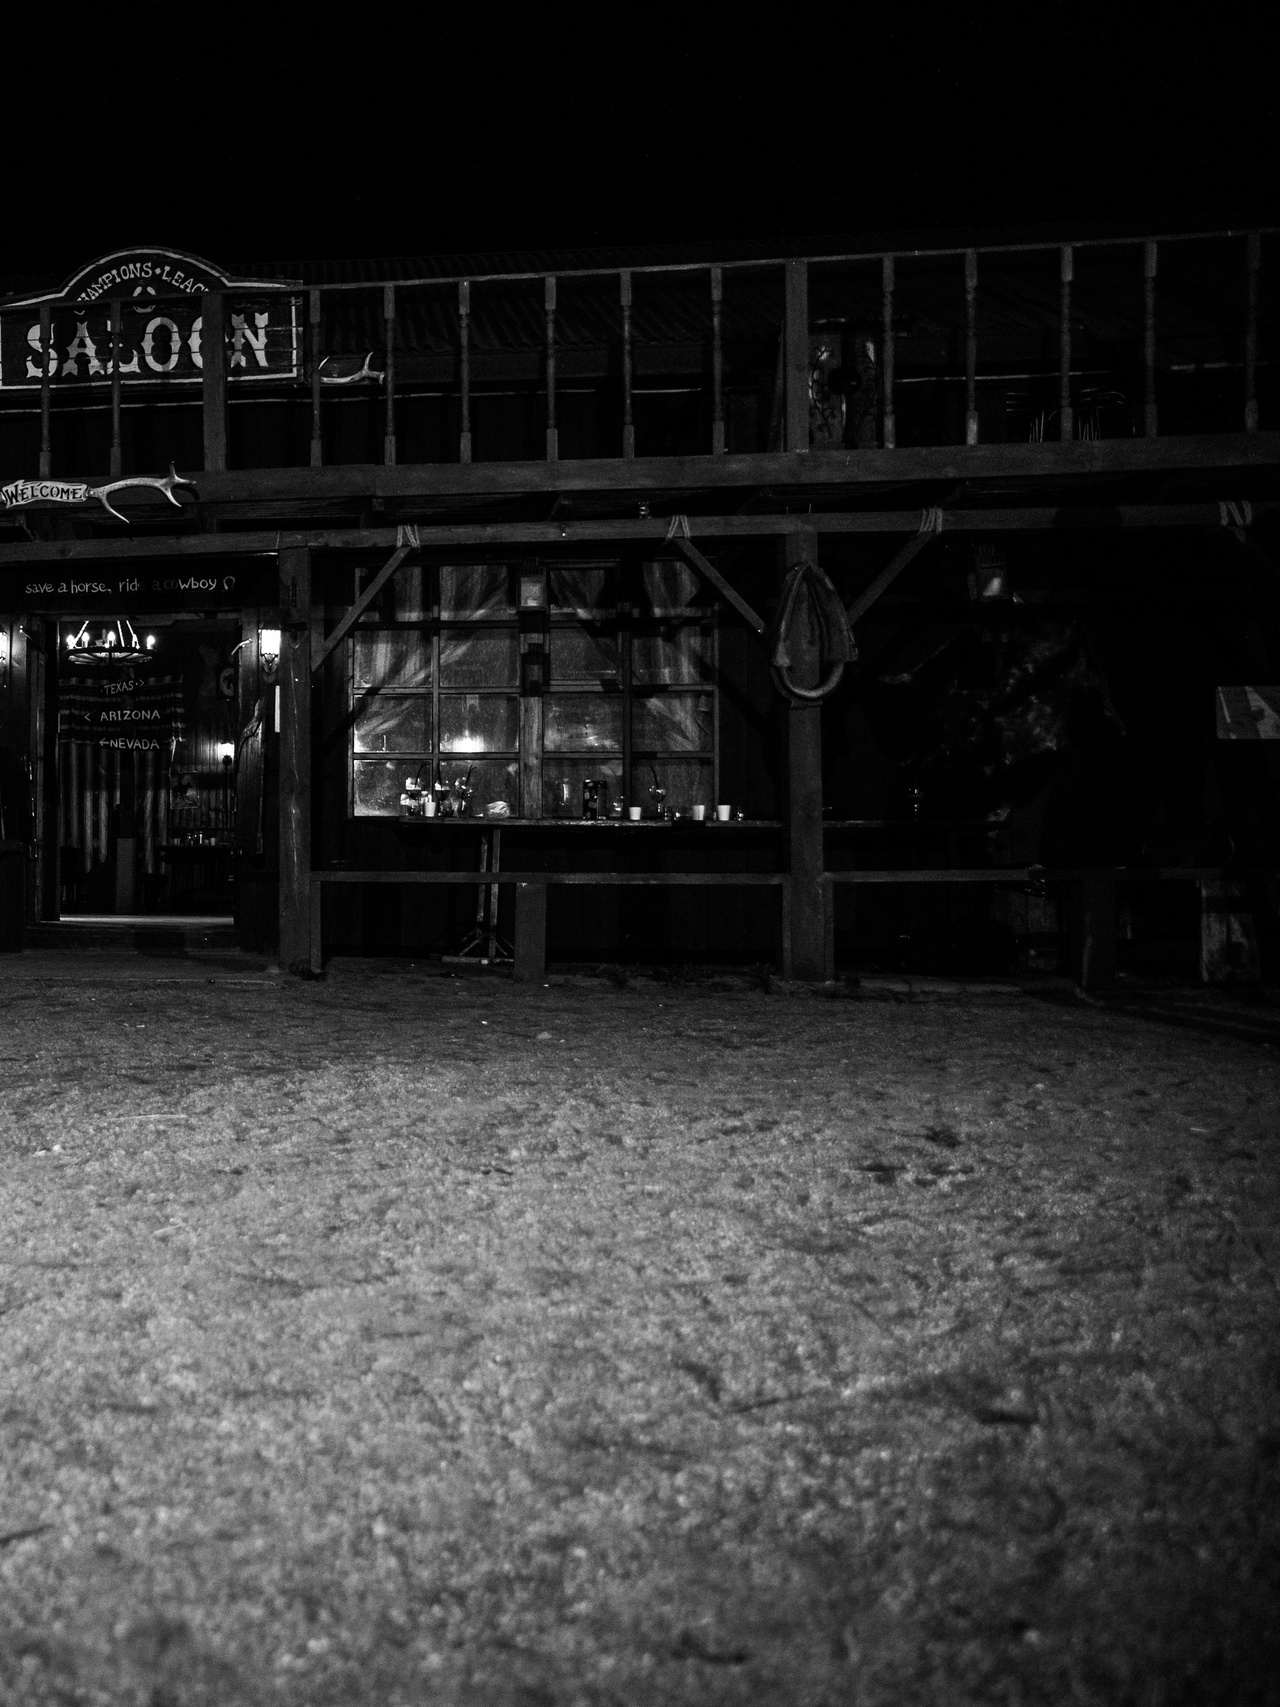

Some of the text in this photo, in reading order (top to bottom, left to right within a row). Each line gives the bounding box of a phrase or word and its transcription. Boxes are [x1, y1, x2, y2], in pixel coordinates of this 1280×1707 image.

[73, 262, 153, 316] HAMPIONS
[5, 485, 83, 504] WELCOME
[25, 577, 218, 595] save a horse, ride a cowboy
[103, 680, 134, 695] TEXAS
[100, 709, 161, 722] ARIZONA
[109, 738, 160, 751] NEVADA
